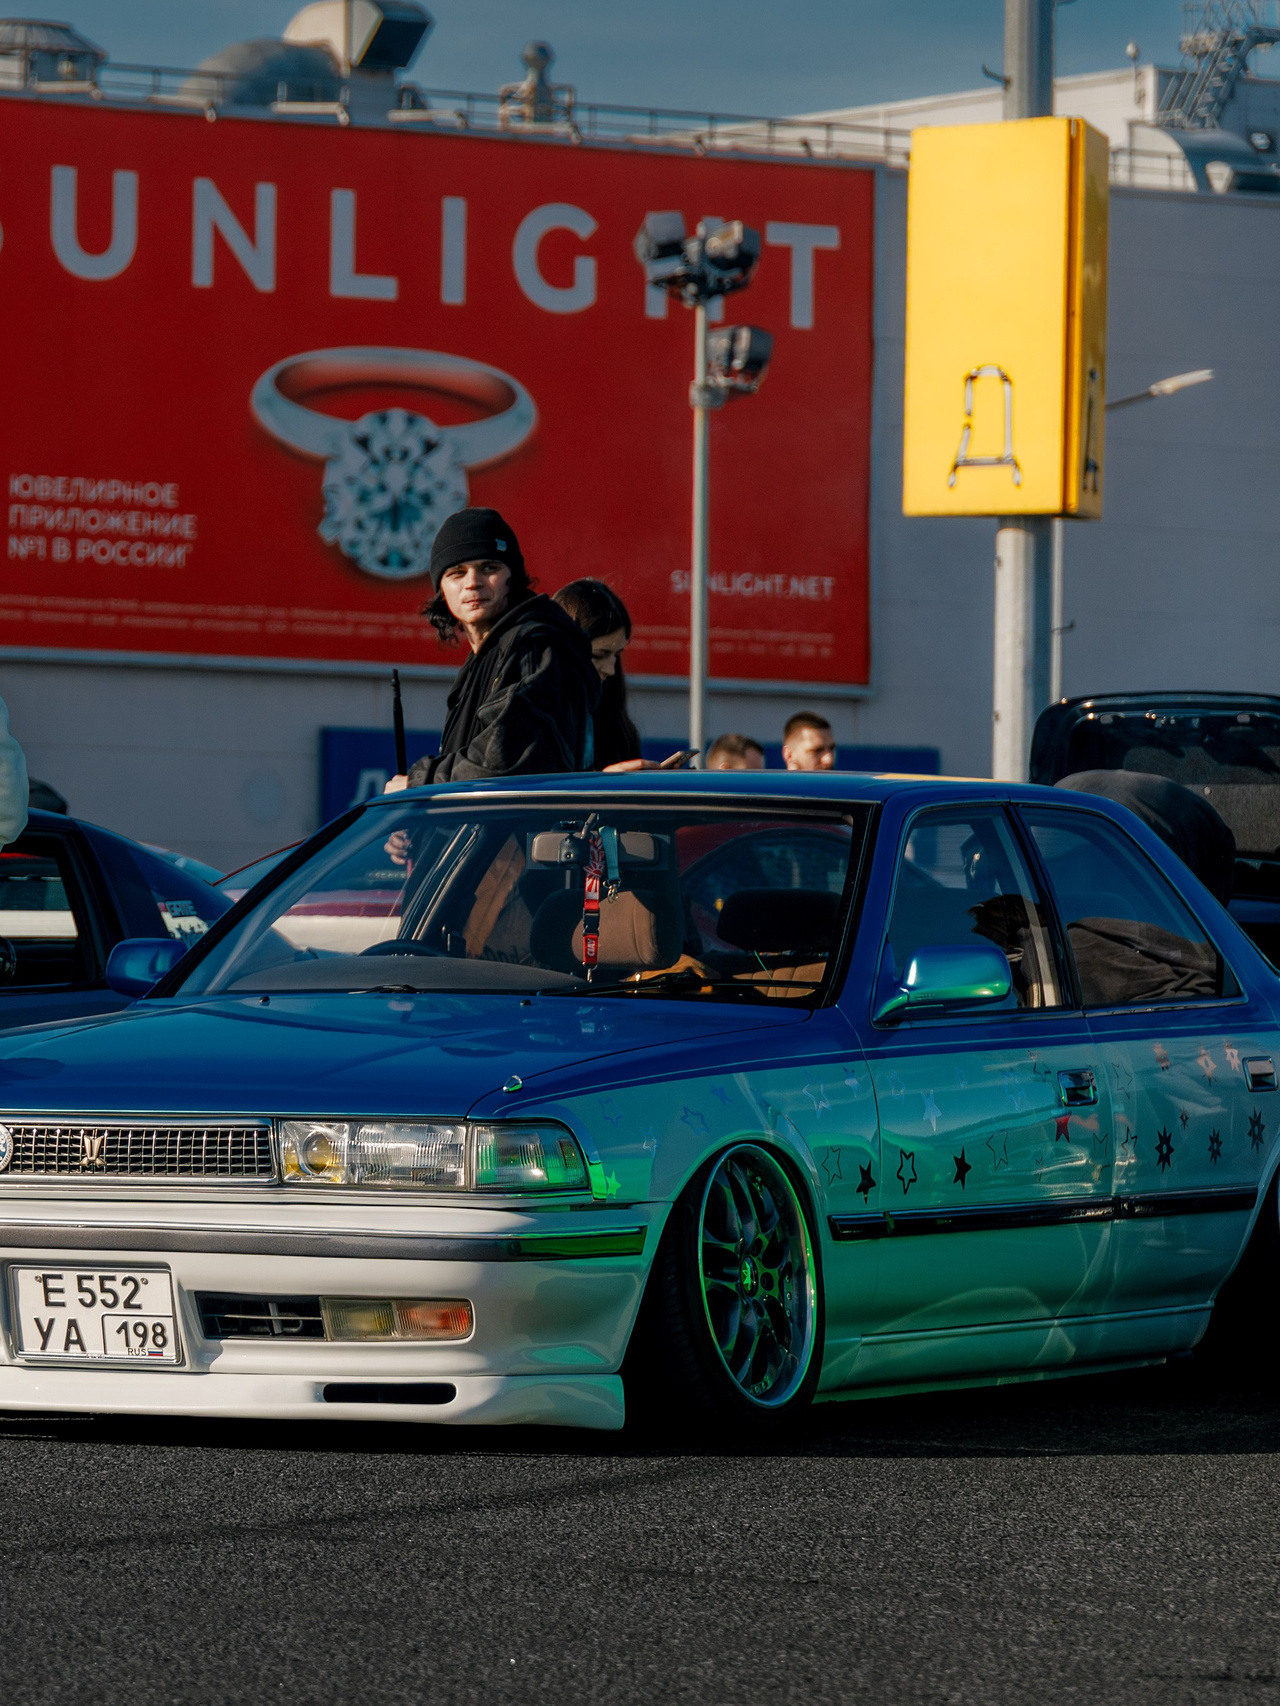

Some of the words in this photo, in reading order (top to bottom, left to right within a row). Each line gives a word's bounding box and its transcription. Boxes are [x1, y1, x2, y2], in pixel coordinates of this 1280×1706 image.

[8, 473, 180, 508] ЮВЕЛИРНОЕ
[8, 503, 198, 540] ПРИЛОЖЕНИЕ
[51, 537, 71, 563] В
[116, 1320, 168, 1349] 198
[127, 1347, 148, 1356] RUS
